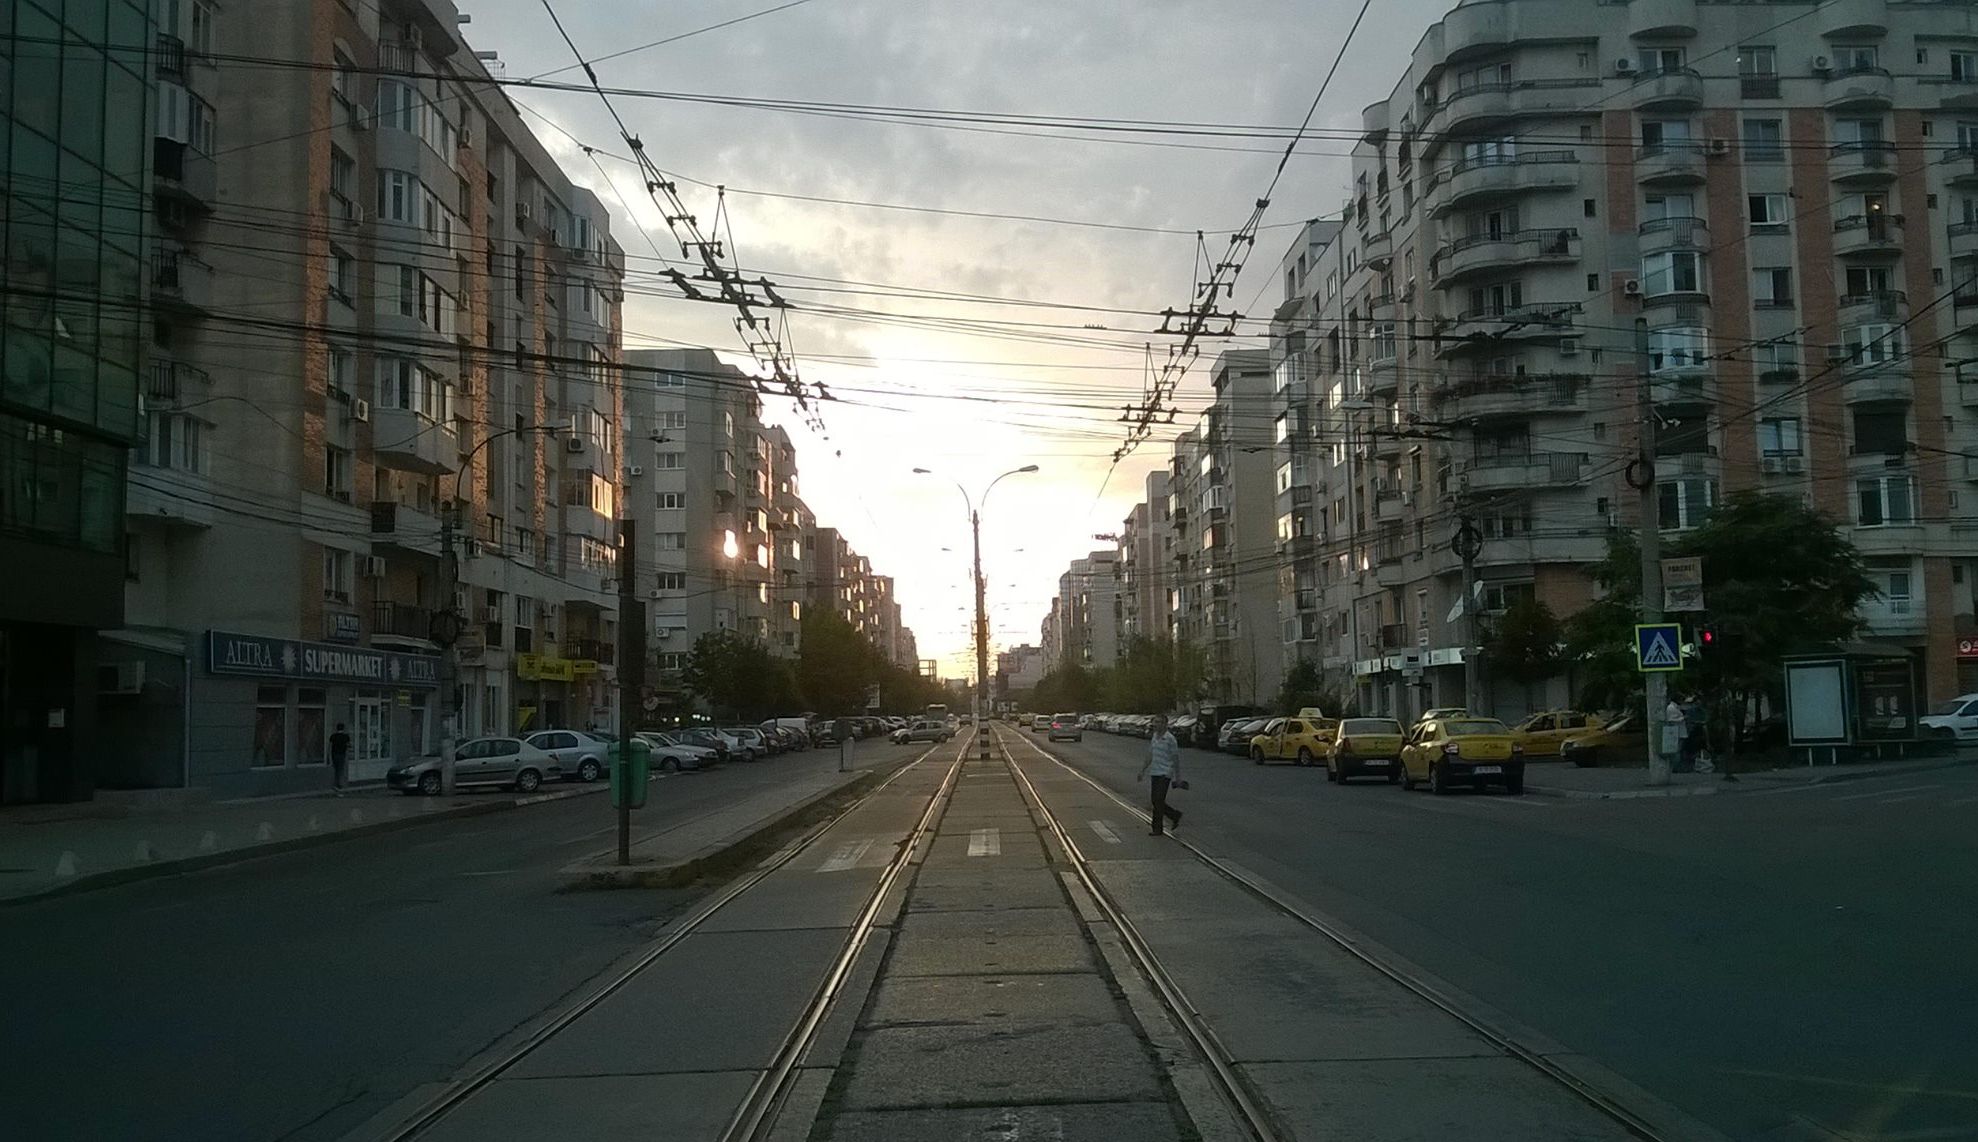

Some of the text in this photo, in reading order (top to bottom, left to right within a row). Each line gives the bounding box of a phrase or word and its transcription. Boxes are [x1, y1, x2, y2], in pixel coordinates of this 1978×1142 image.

[226, 640, 436, 681] ALTRA SUPERMARKET ALTRA
